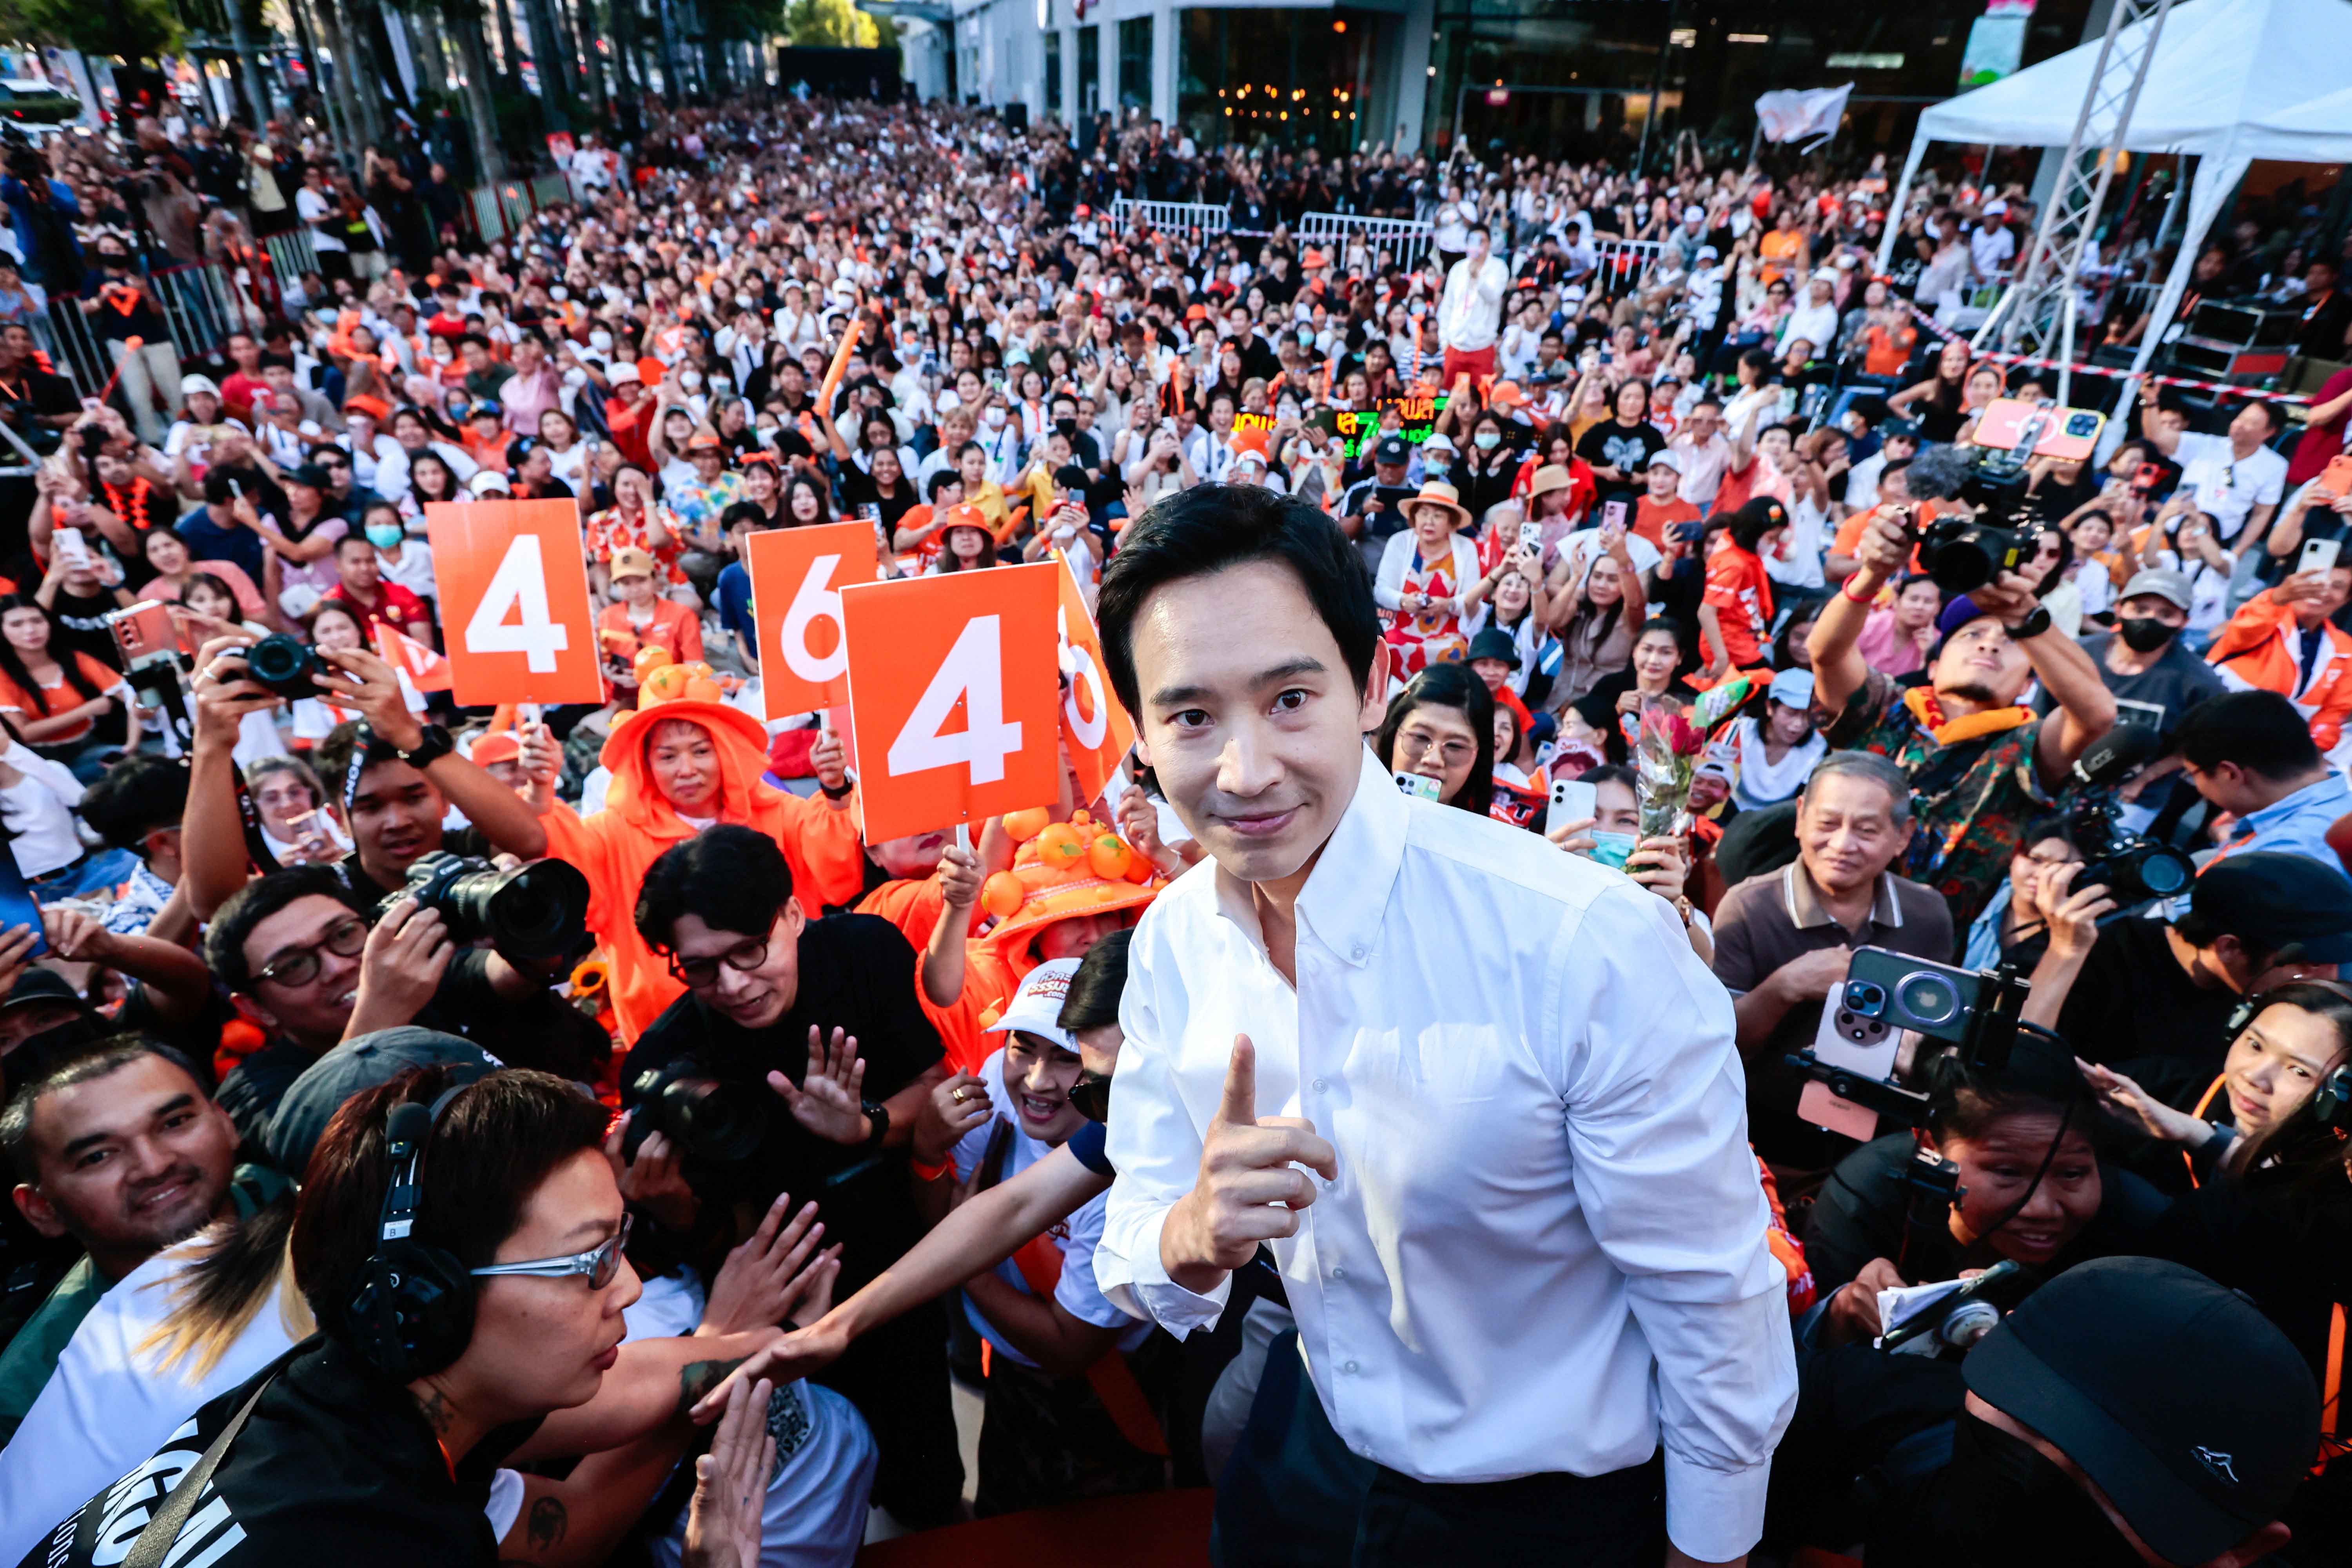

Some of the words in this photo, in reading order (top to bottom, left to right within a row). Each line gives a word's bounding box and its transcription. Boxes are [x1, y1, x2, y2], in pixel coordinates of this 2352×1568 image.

[465, 534, 568, 673] 4
[780, 554, 846, 682] 6
[887, 614, 1022, 786] 4
